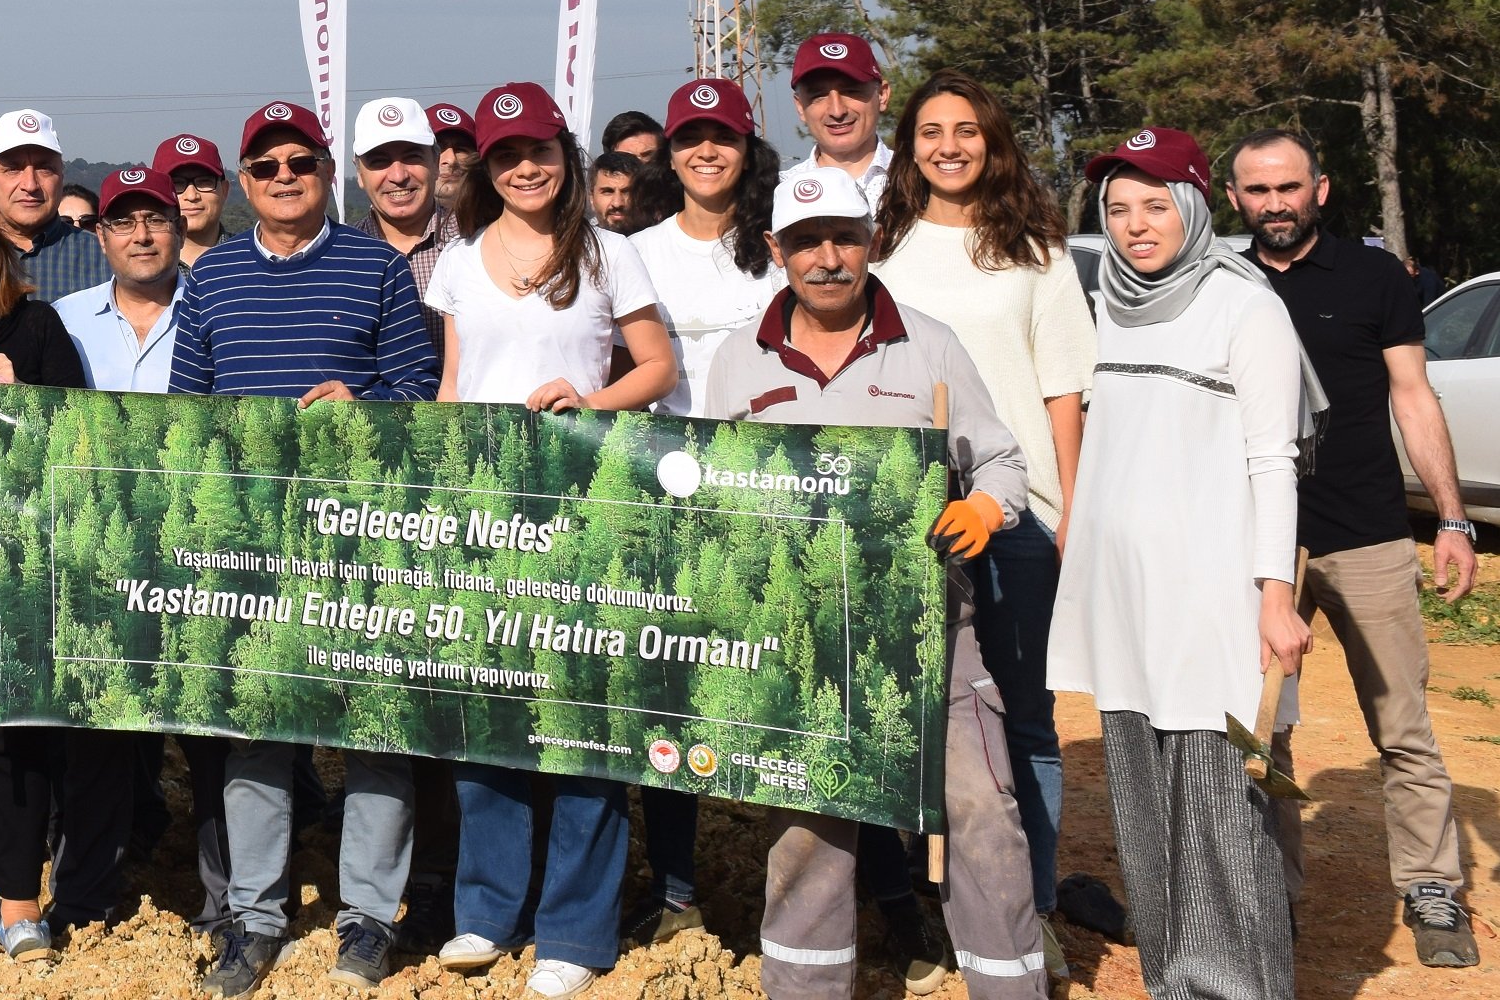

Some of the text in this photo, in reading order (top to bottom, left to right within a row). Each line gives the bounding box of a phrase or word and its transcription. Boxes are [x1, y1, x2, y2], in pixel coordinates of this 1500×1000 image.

[880, 389, 915, 400] kastamonu
[817, 453, 851, 476] 50
[705, 463, 850, 495] kastamonu
[306, 498, 570, 553] "Geleceğe Nefes"
[173, 548, 698, 614] Yaşanabilir bir hayat için toprağa, fidana, geleceğe dokunuyoruz.
[115, 579, 778, 670] "Kastamonu Entegre 50. Yıl Hatıra Ormanı"
[307, 645, 555, 690] ile geleceğe yatırım yapıyoruz.
[528, 733, 632, 755] gelecegenefes.com
[731, 752, 808, 776] GELECEĞE
[759, 771, 807, 791] NEFES
